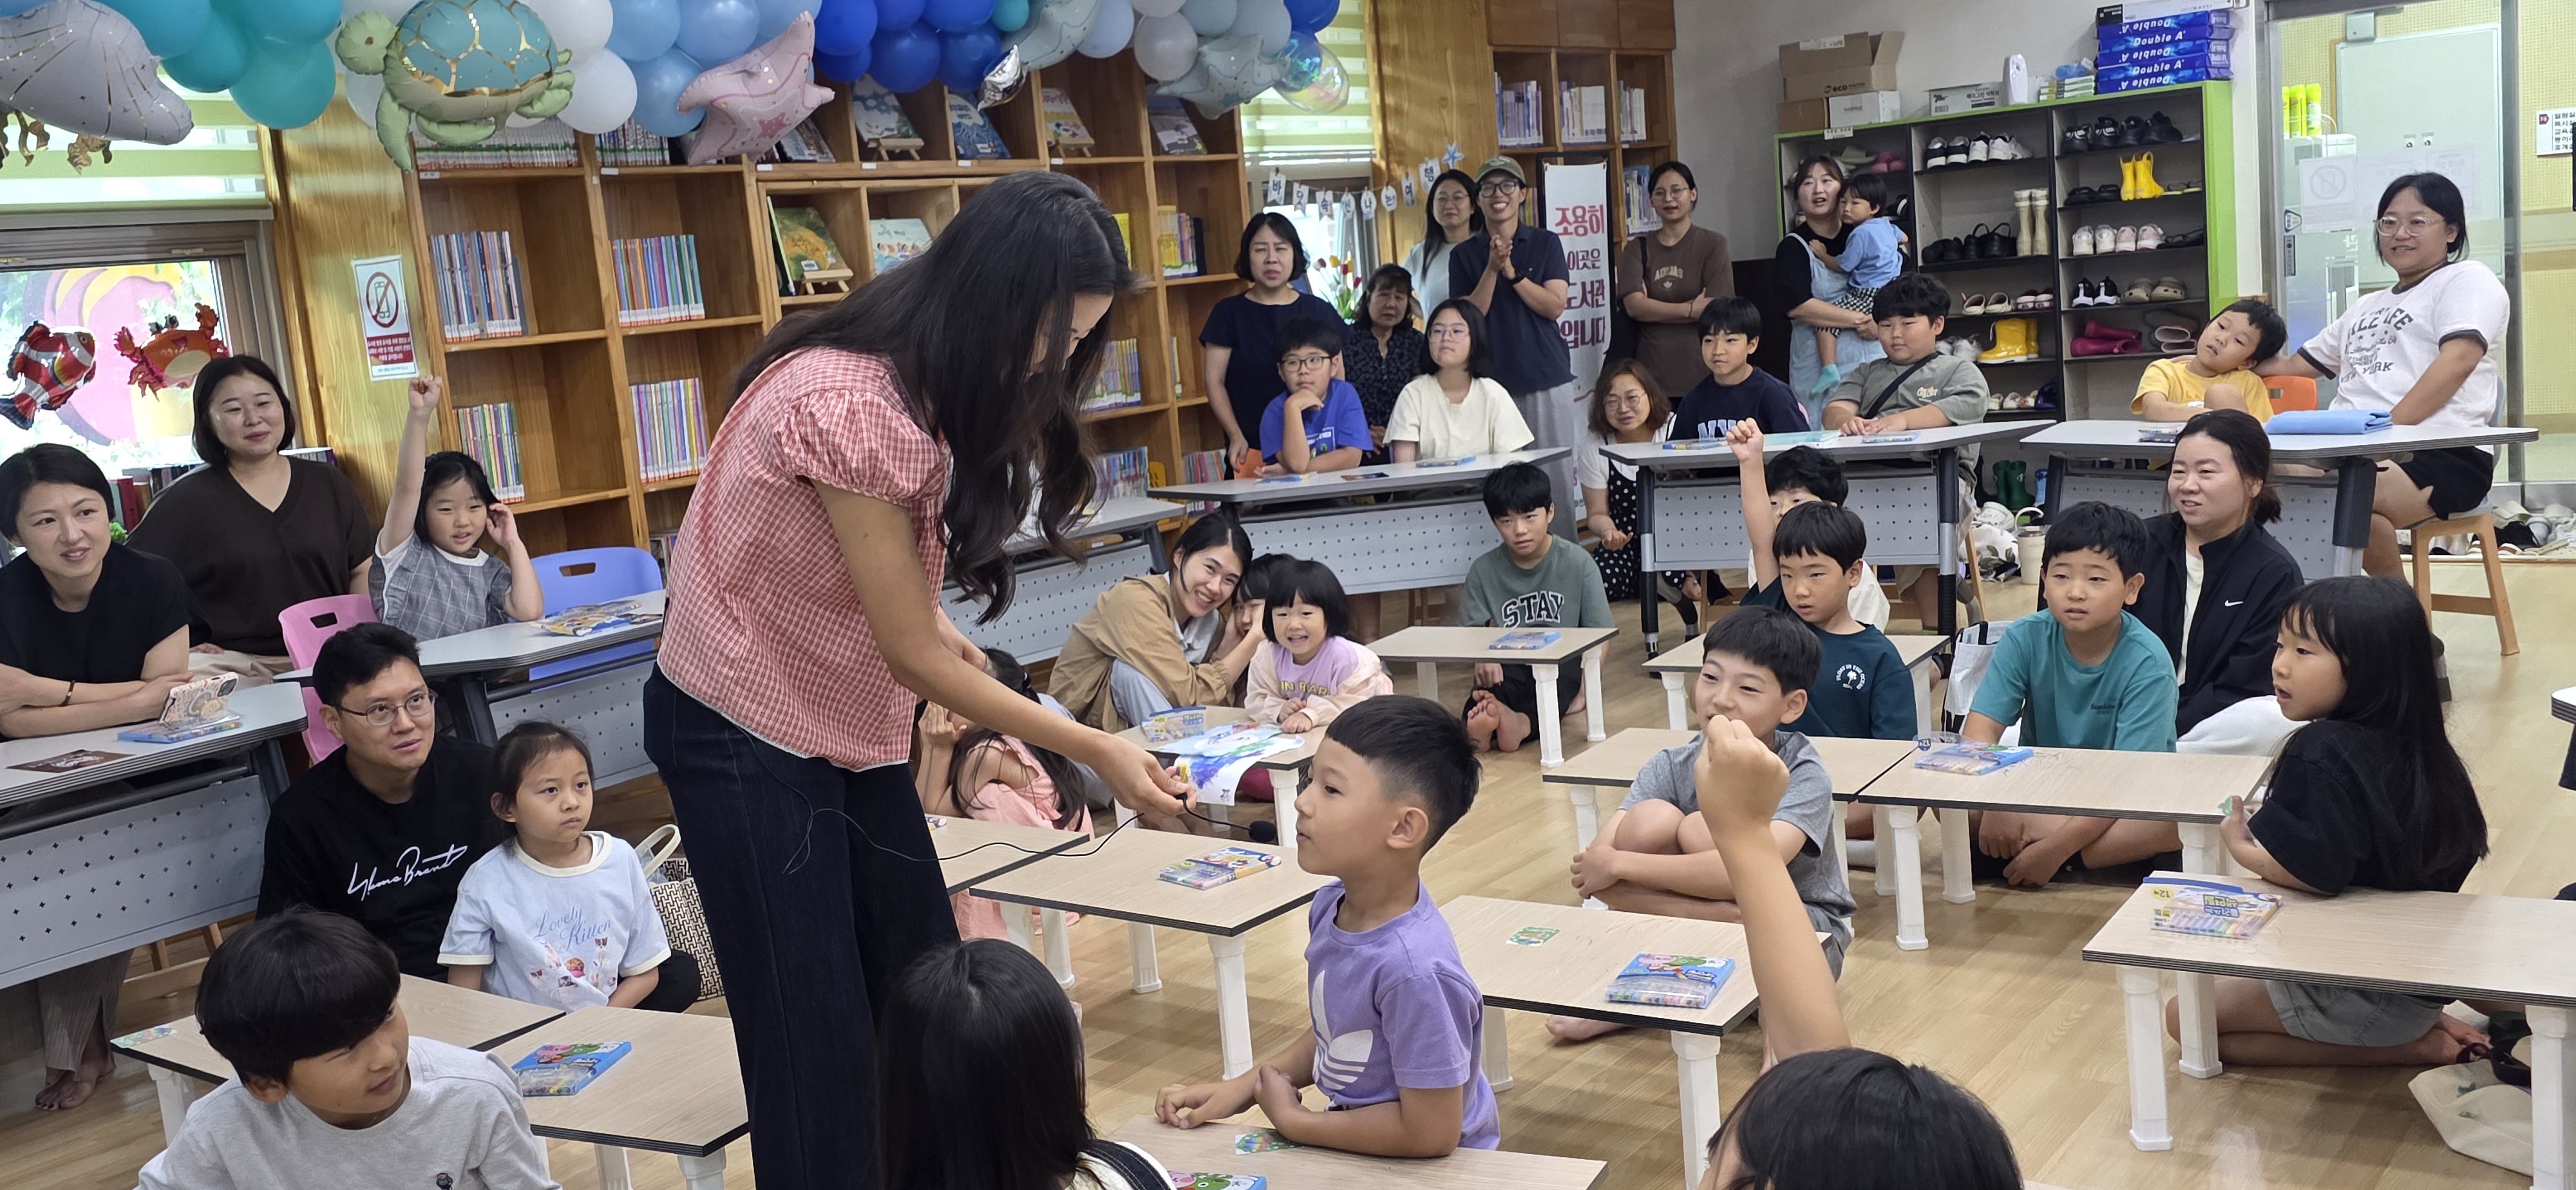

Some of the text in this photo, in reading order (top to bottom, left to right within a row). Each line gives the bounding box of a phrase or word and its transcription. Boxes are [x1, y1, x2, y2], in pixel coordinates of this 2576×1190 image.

[2133, 19, 2172, 31] Double
[2133, 32, 2183, 46] Double A
[2132, 48, 2171, 60] Double
[2132, 60, 2182, 75] Double A
[2132, 75, 2170, 88] Double
[1555, 203, 1605, 237] 조용히
[1567, 248, 1601, 270] 이곳은
[1560, 316, 1606, 349] 입니다
[1501, 590, 1565, 628] STAY
[533, 905, 582, 941] Lovely
[560, 920, 611, 952] Kitten
